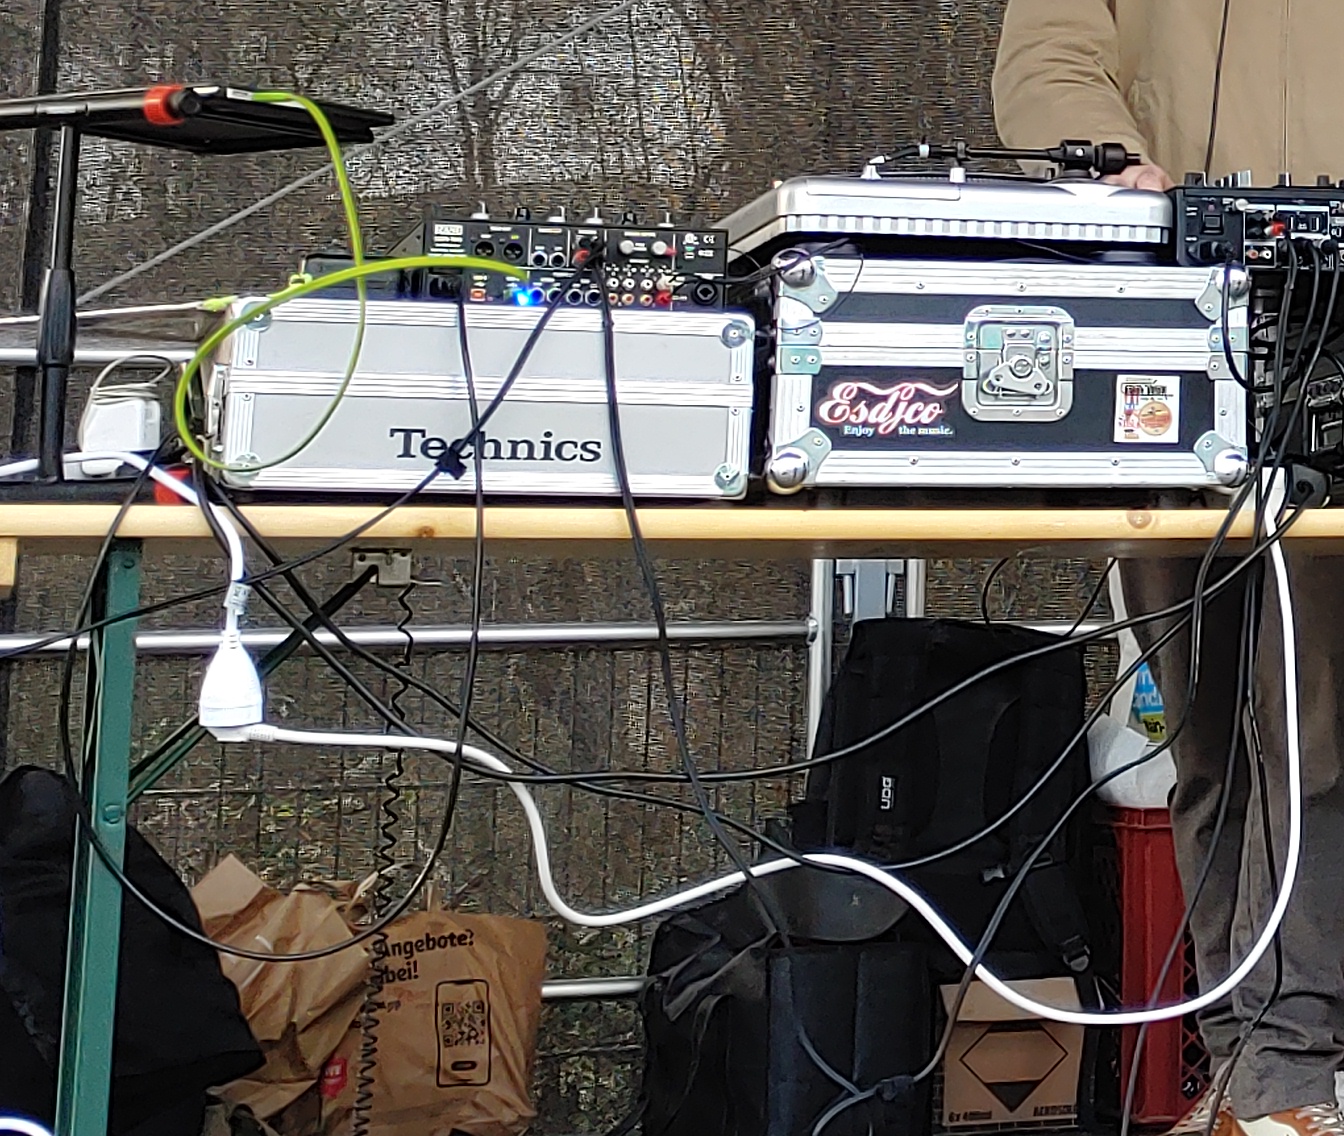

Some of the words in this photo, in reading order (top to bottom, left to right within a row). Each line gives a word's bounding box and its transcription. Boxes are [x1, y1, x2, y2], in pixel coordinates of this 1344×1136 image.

[843, 425, 876, 438] Enjoy
[898, 425, 916, 435] the
[880, 775, 893, 811] UDG
